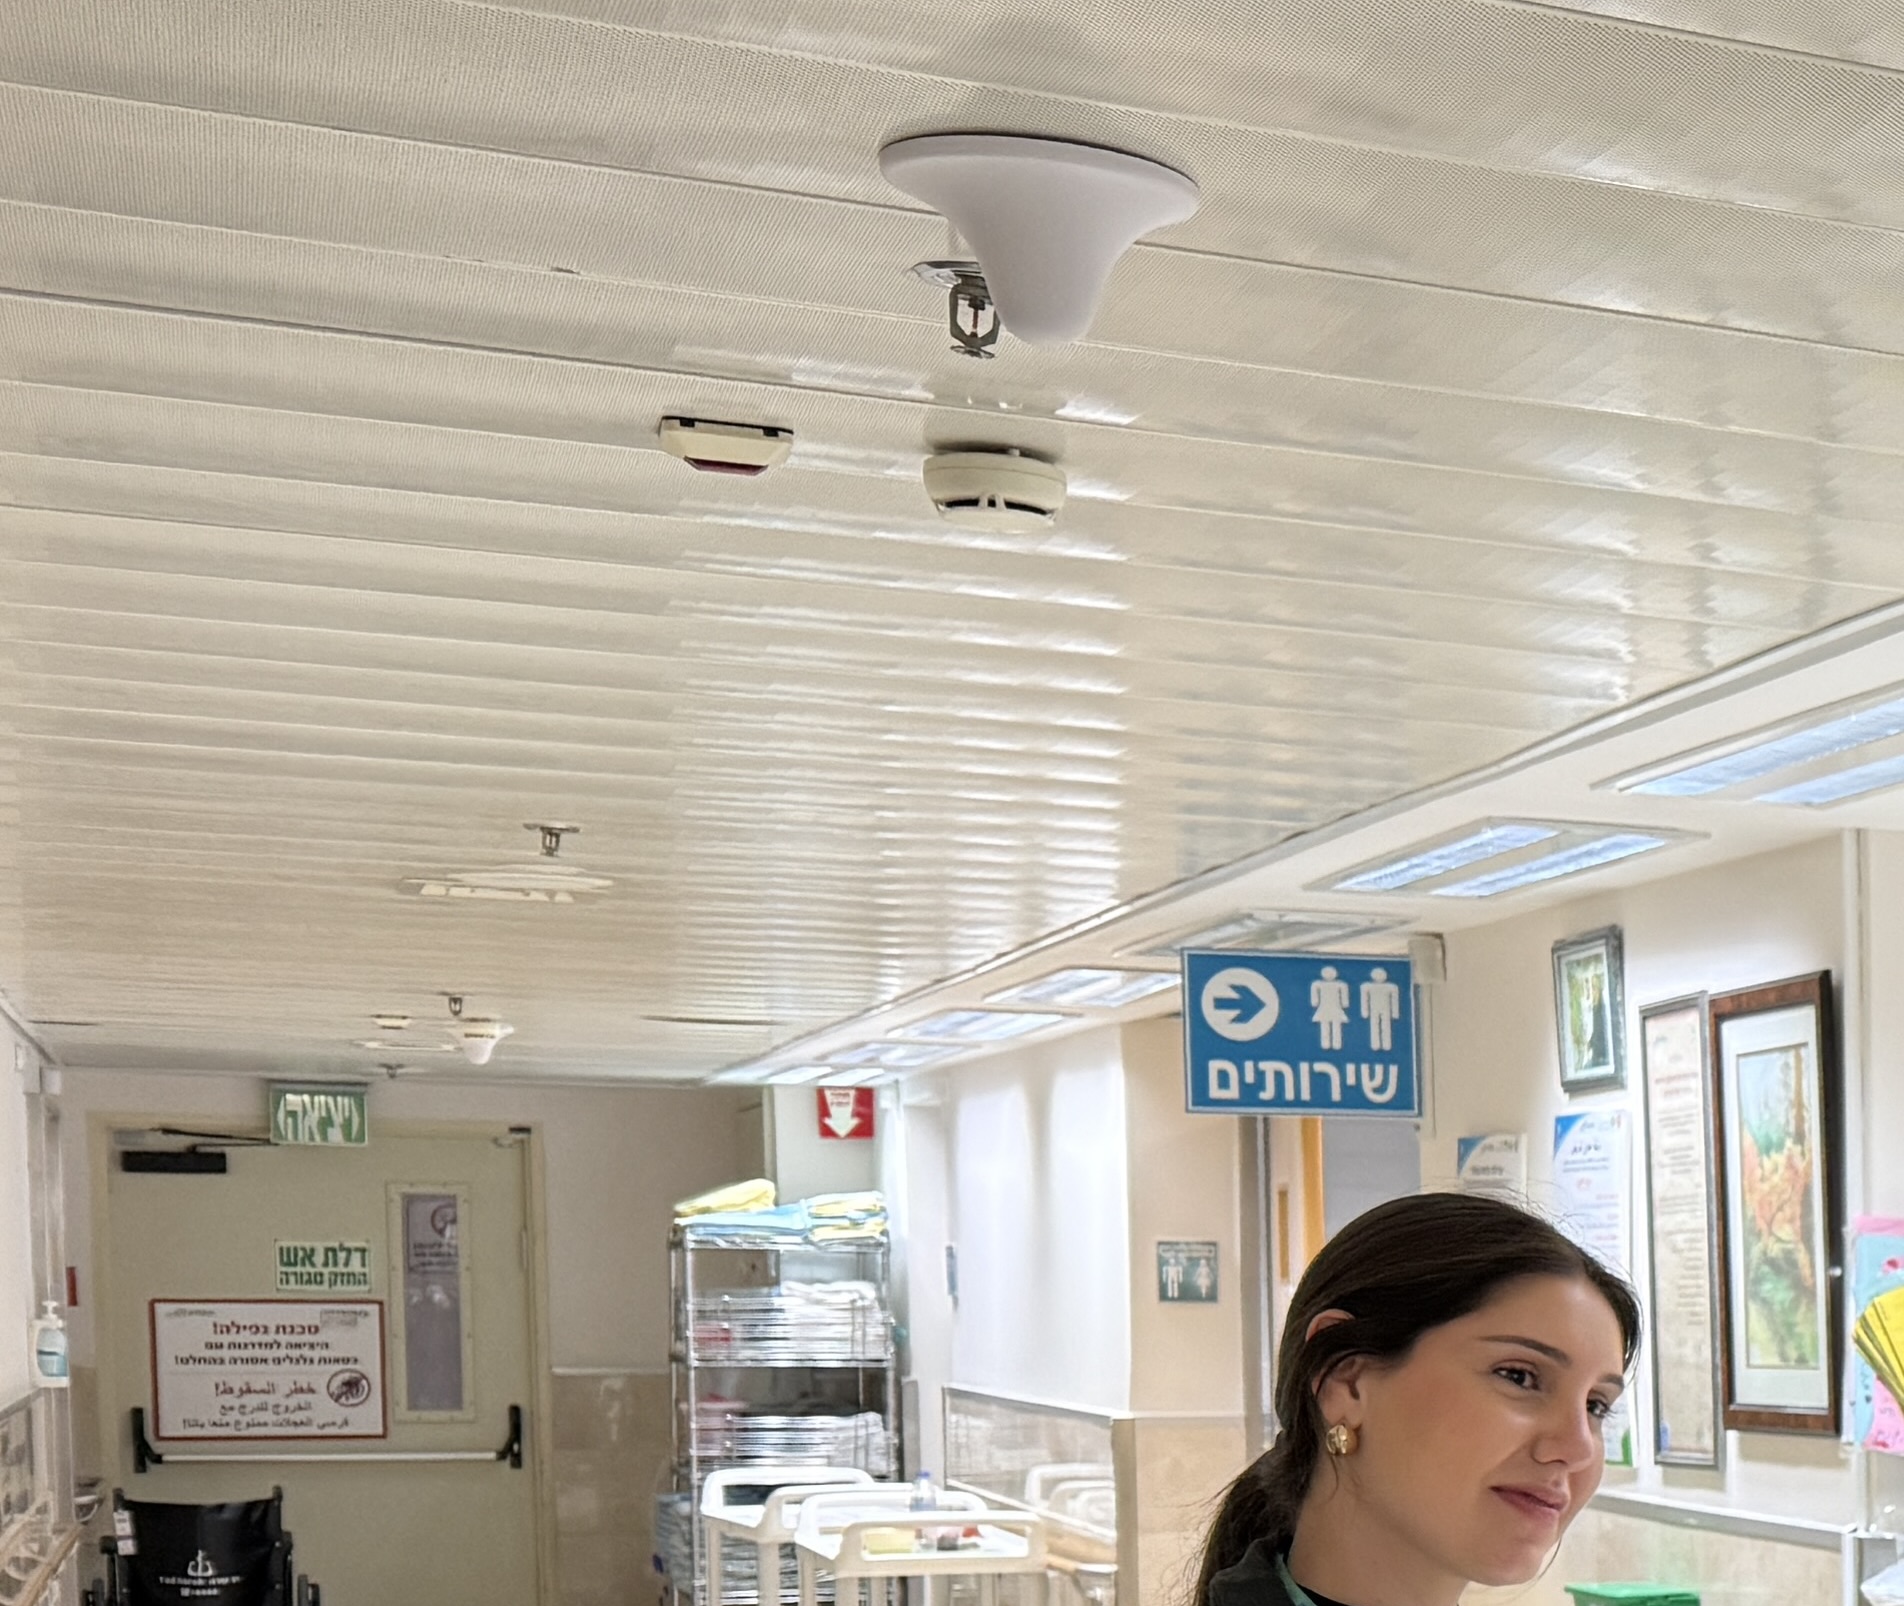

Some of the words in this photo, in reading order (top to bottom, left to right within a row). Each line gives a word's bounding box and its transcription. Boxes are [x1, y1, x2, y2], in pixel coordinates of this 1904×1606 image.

[1208, 1059, 1399, 1104] שירותים
[285, 1093, 350, 1143] יציאה
[279, 1246, 317, 1268] אש
[321, 1242, 367, 1268] דלת
[280, 1271, 325, 1286] סגורה
[275, 1323, 320, 1336] סכנת
